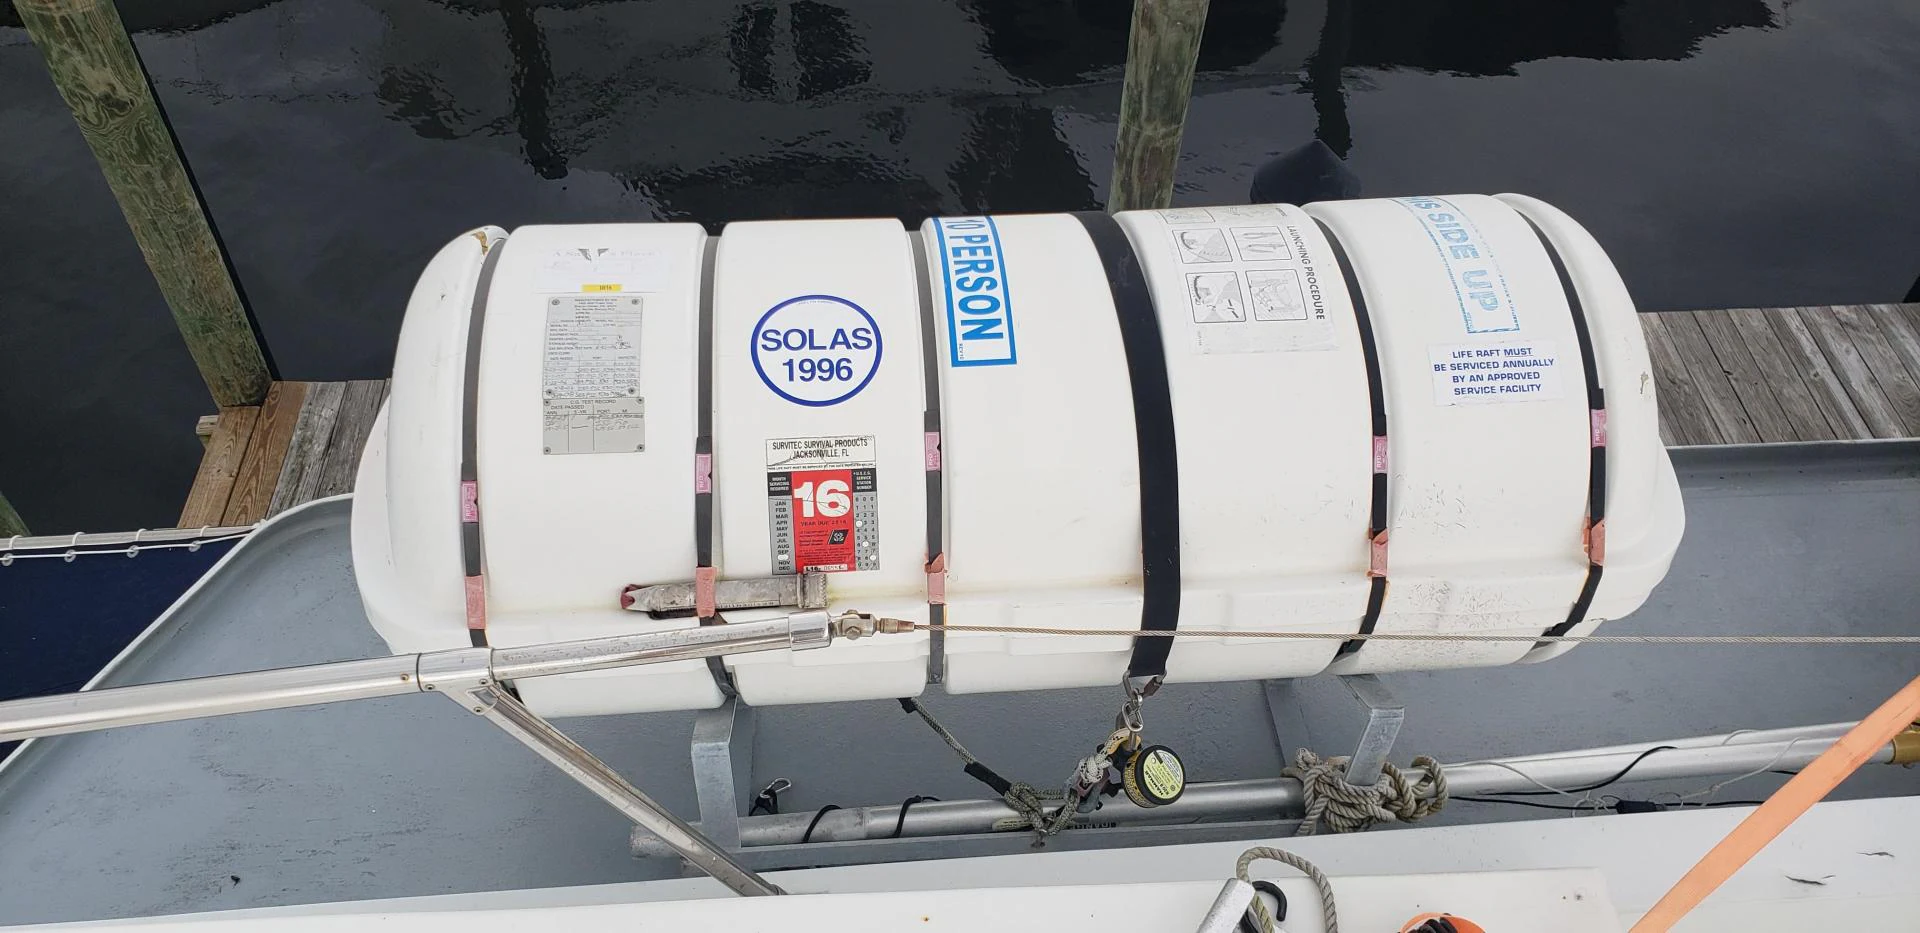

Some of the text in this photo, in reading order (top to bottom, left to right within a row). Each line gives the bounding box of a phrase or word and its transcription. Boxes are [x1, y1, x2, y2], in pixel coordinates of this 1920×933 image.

[1286, 226, 1325, 320] LAUNCHING PROCEDURE
[1428, 214, 1480, 259] SIDE
[1462, 270, 1498, 311] UP
[944, 219, 1004, 340] 10 PERSON
[761, 328, 872, 351] SOLAS
[1434, 358, 1554, 371] BE SERVICED ANNUALLY
[1452, 348, 1532, 358] LIFE RAFT MUST
[782, 358, 852, 382] 1996
[1488, 372, 1540, 381] APPROVED
[1454, 384, 1541, 395] SERVICE FACILITY
[772, 439, 868, 450] SURVITEC SURVIVAL PRODUCTS
[794, 480, 851, 518] 16
[1145, 771, 1163, 795] HAMMAR
